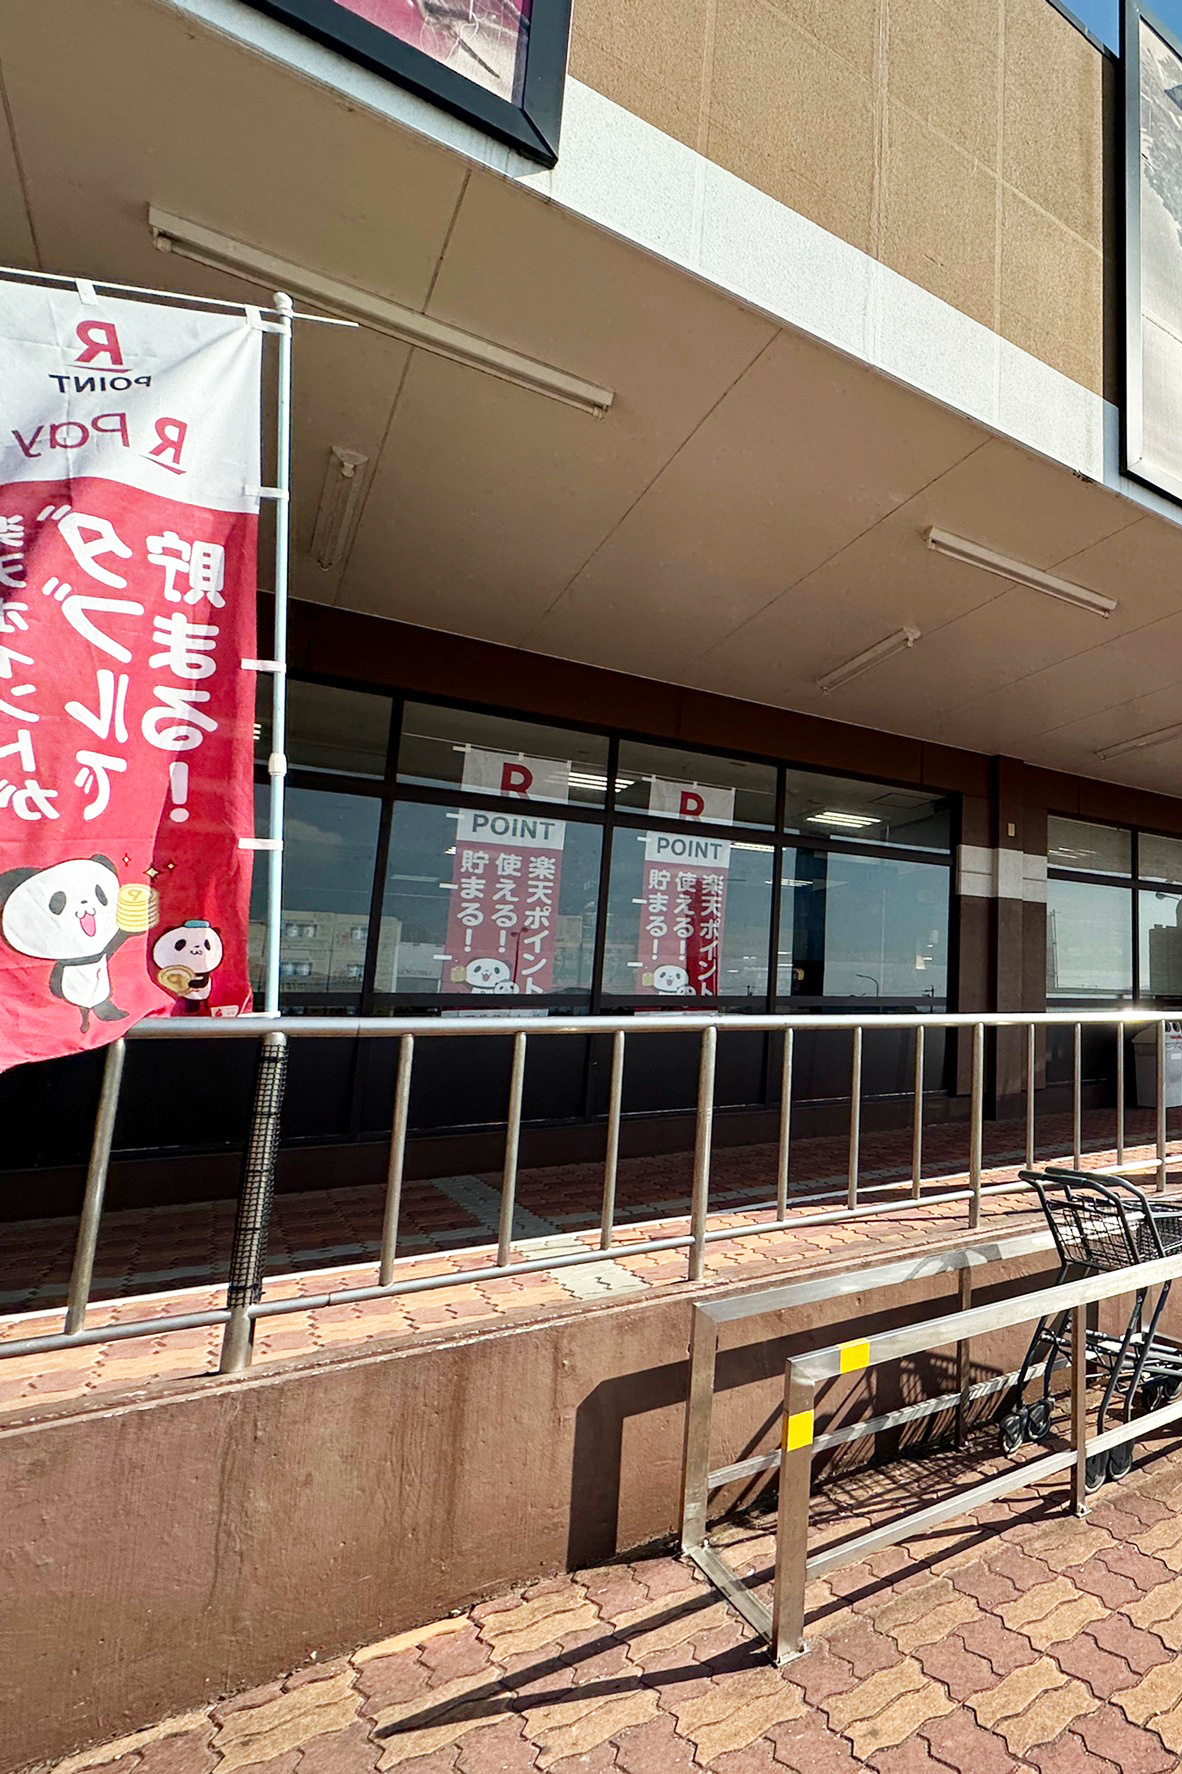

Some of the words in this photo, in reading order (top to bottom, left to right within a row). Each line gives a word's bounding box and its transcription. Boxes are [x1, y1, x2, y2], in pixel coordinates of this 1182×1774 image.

[471, 813, 556, 840] POINT
[656, 836, 723, 860] POINT
[456, 850, 489, 952] 貯まる！
[490, 852, 522, 953] 使える！
[645, 869, 671, 960] 貯まる！
[672, 871, 698, 961] 使える！
